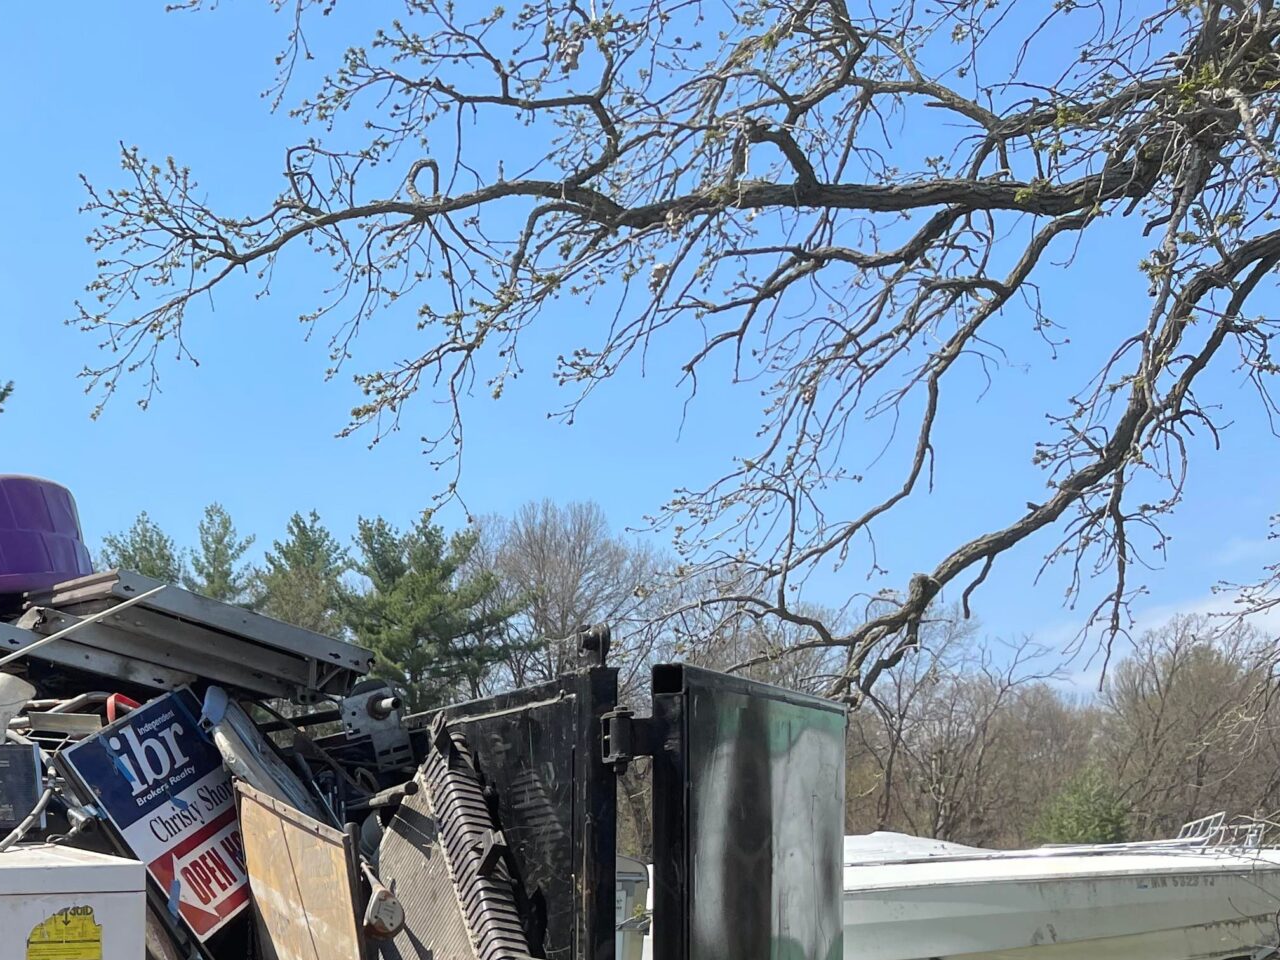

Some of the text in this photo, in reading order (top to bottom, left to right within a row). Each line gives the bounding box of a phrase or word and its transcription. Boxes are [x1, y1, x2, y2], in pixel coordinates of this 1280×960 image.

[137, 709, 175, 736] Independent
[109, 723, 189, 796] ibr
[135, 765, 196, 807] Brokers Realty
[149, 779, 235, 843] Christy Shor
[181, 846, 238, 905] OPEN
[69, 905, 94, 916] GUID
